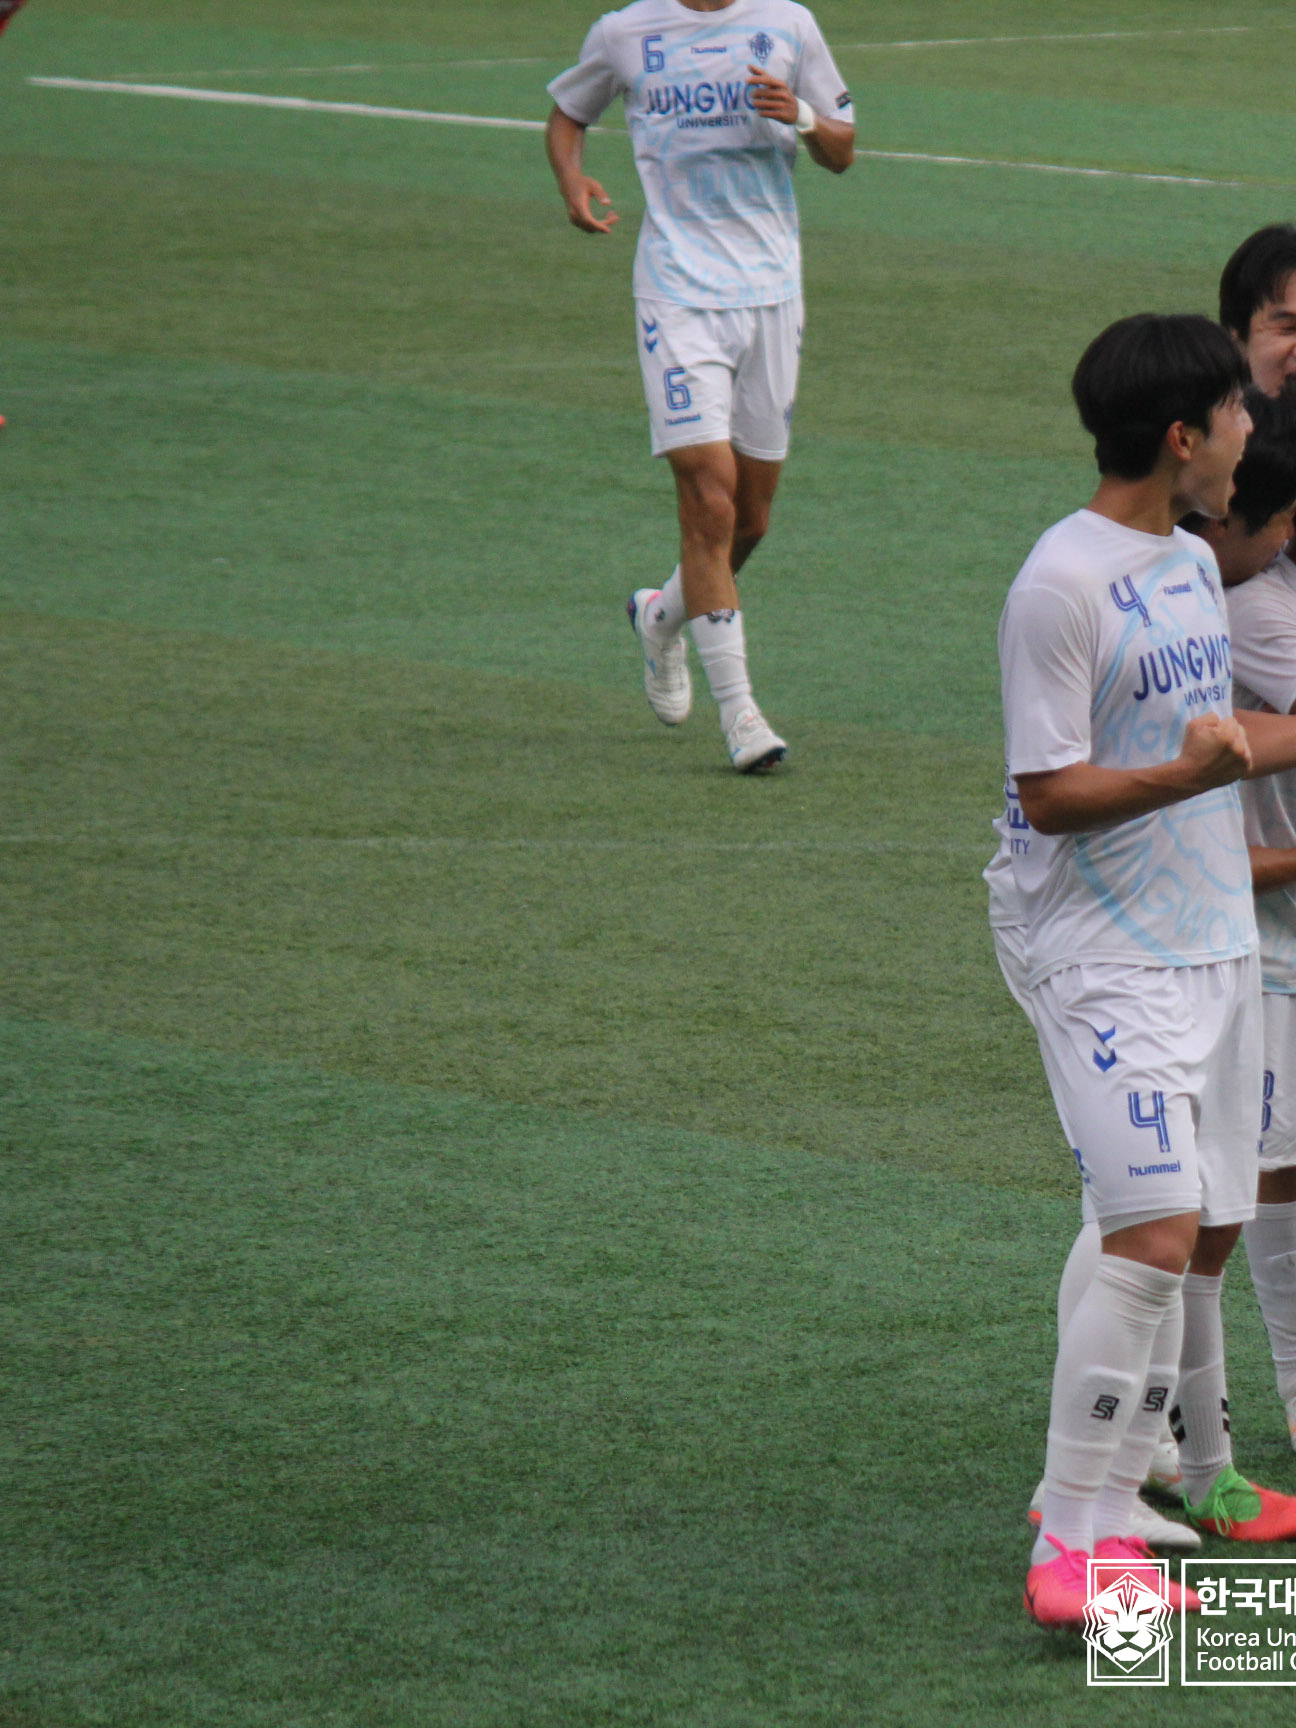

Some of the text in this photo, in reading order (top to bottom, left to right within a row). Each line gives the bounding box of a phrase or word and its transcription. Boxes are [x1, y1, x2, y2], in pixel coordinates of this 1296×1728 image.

[641, 34, 665, 73] 6
[677, 115, 749, 129] UNIVERSITY
[664, 366, 692, 411] 6
[1109, 574, 1152, 628] 4
[1128, 1090, 1171, 1154] 4
[1128, 1160, 1181, 1178] hummel
